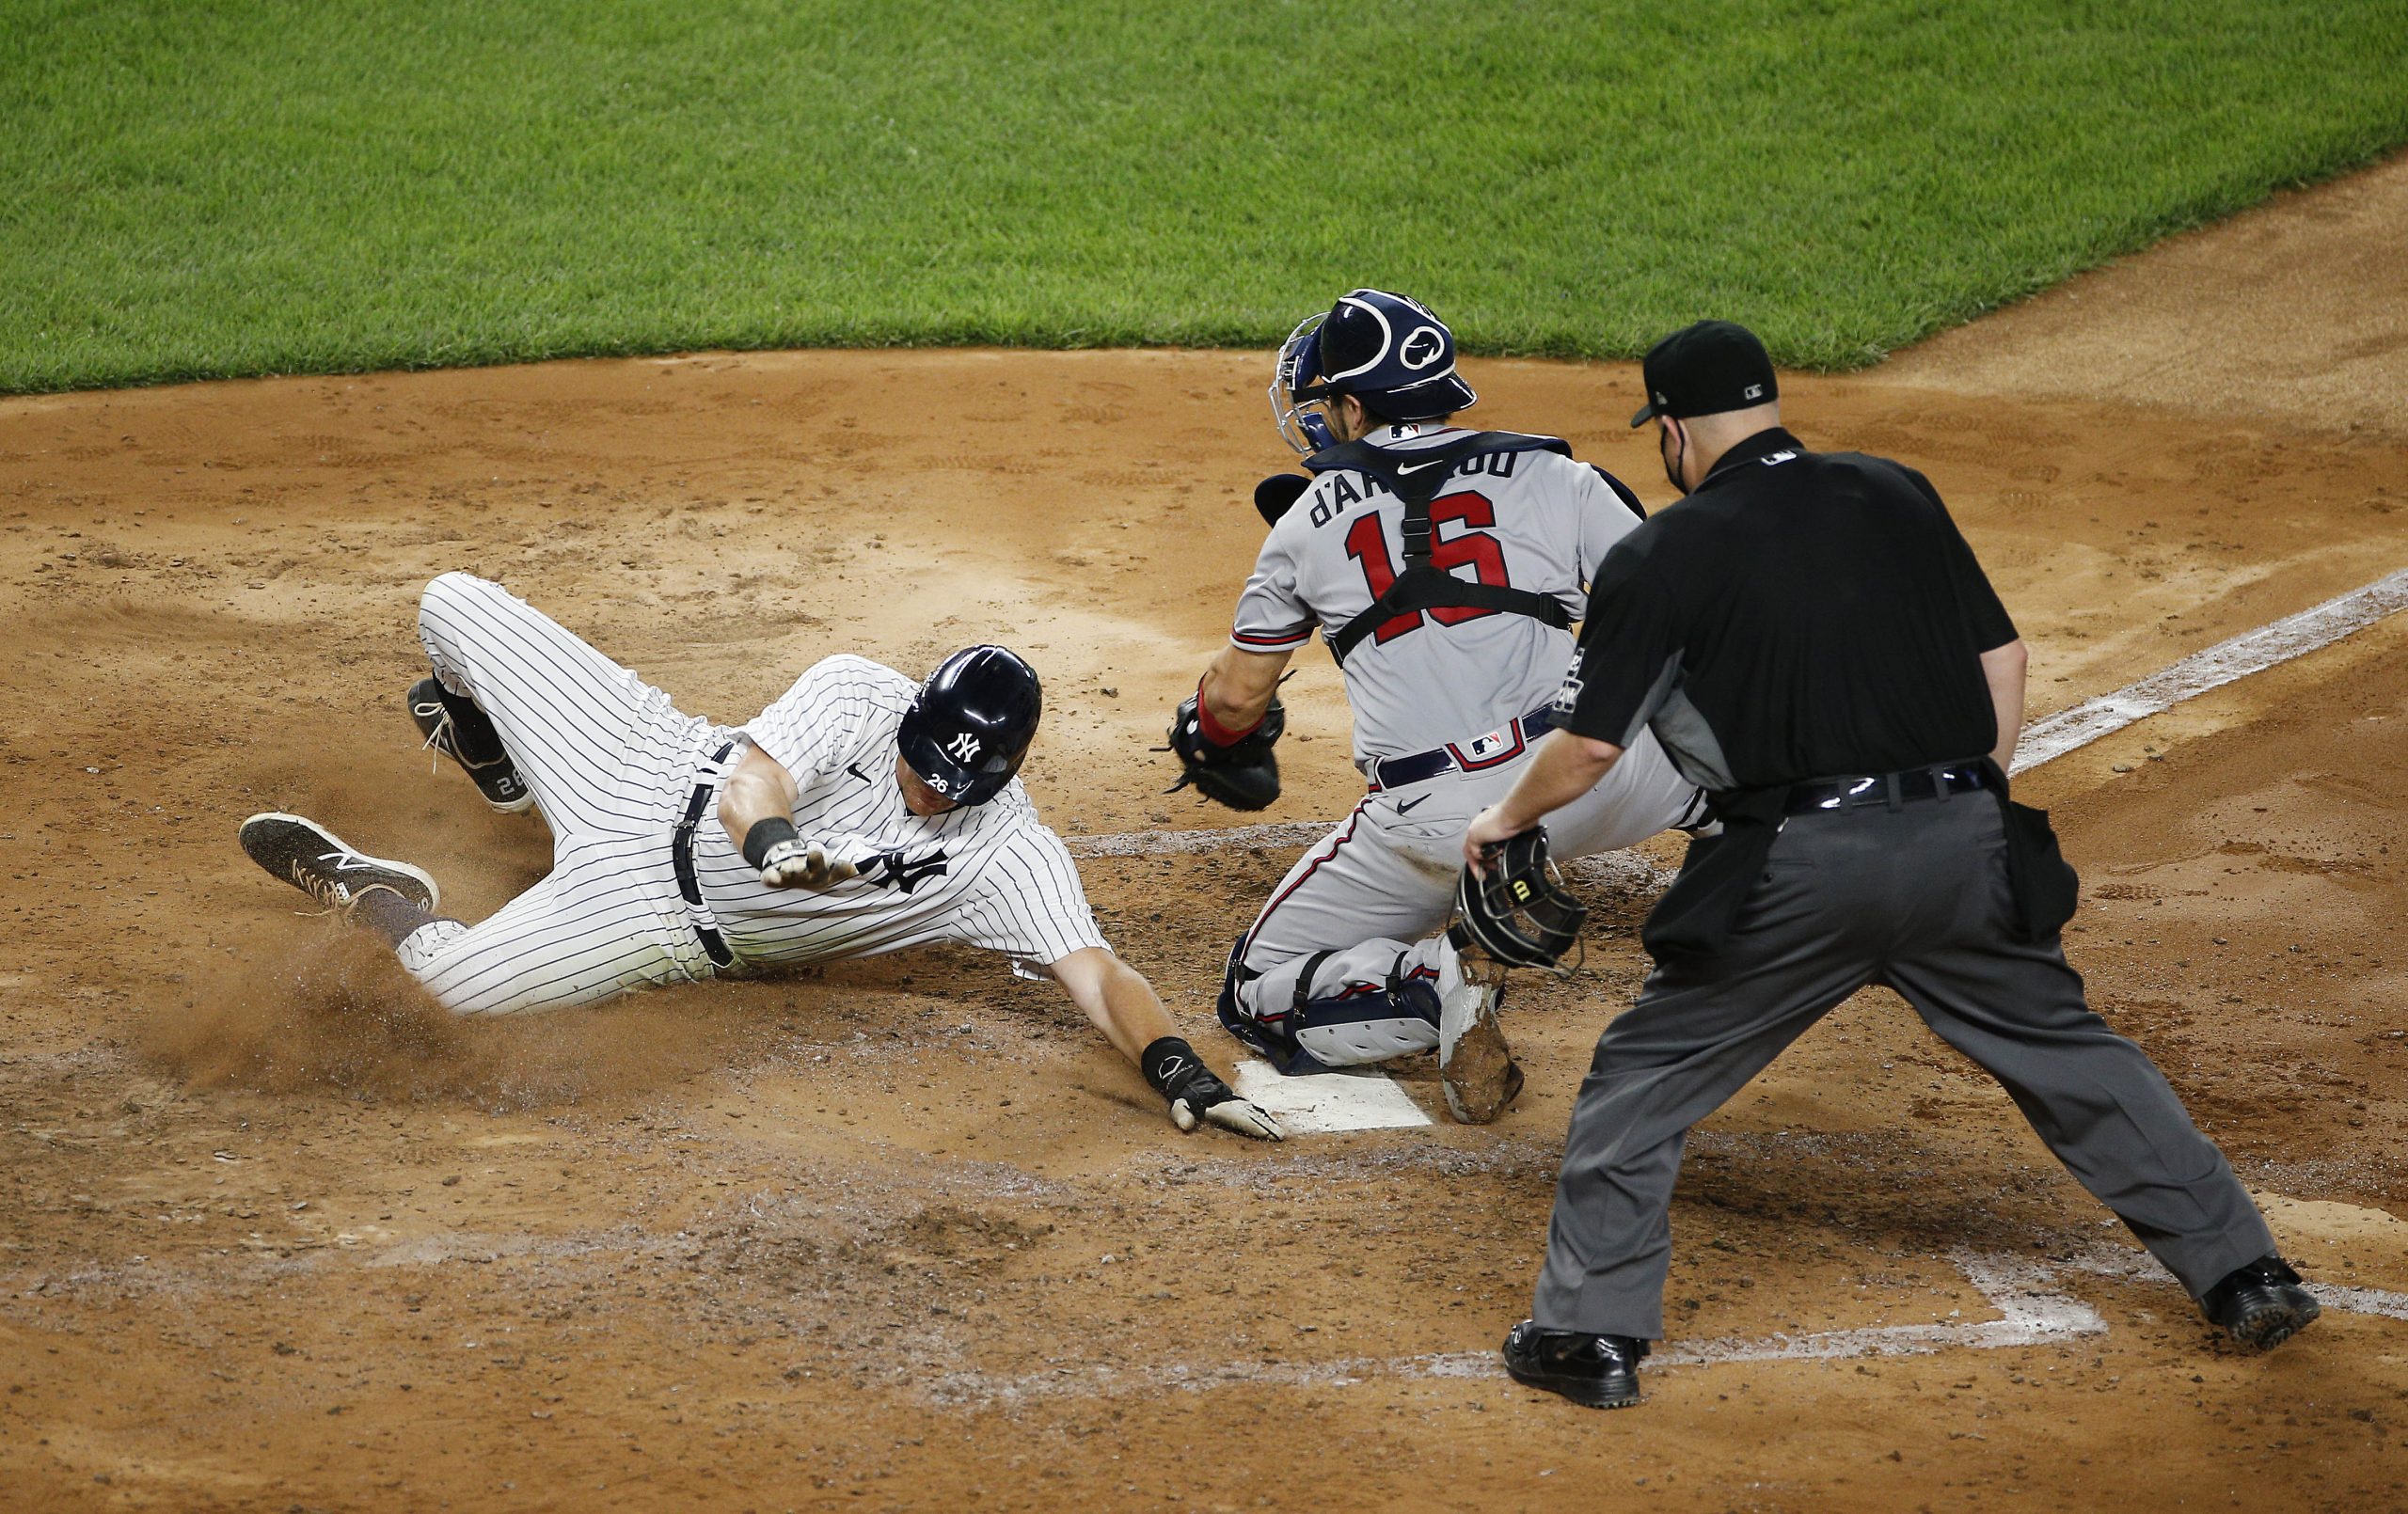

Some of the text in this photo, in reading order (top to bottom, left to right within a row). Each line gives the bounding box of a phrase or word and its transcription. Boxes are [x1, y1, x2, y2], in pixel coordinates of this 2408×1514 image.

[1344, 490, 1512, 646] 16
[947, 733, 981, 763] NY
[927, 773, 949, 794] 26
